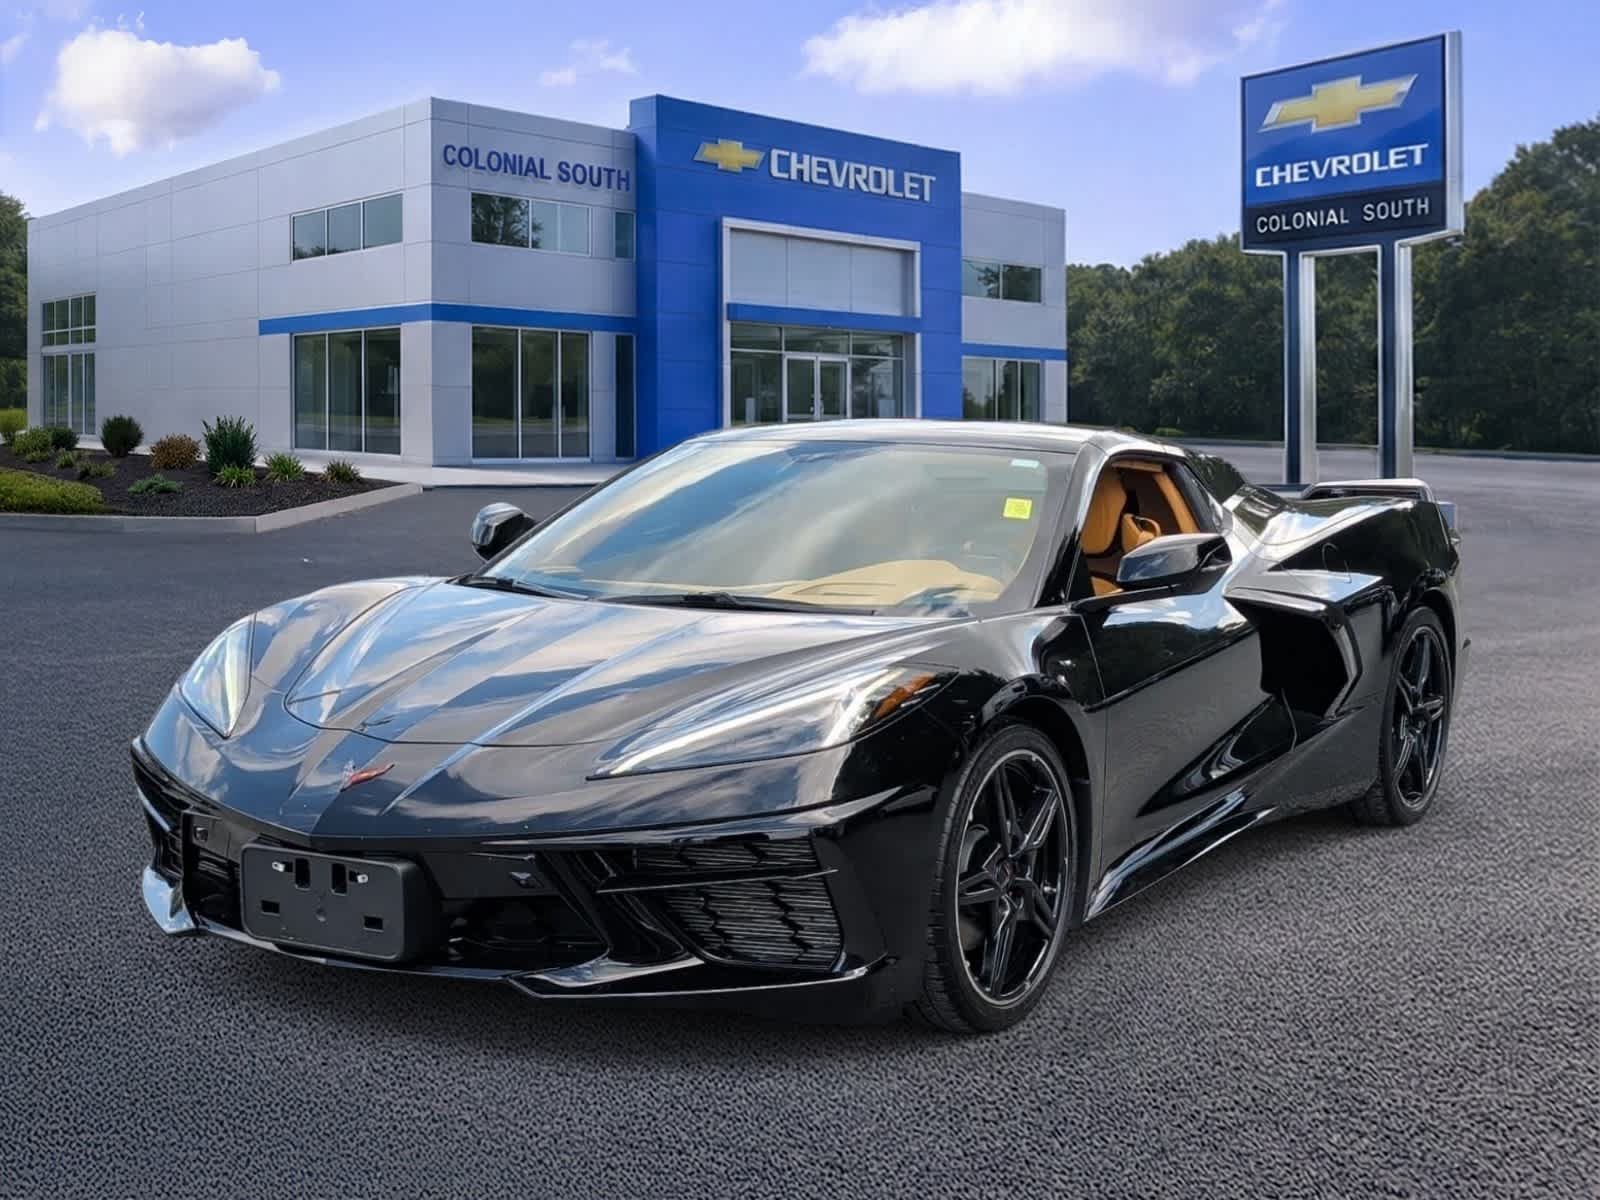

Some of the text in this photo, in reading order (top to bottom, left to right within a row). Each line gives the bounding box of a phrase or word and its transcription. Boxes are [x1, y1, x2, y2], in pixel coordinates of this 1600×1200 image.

[443, 144, 630, 191] COLONIAL SOUTH
[770, 148, 936, 202] CHEVROLET
[1255, 143, 1429, 187] CHEVROLET
[1256, 197, 1430, 233] COLONIAL SOUTH
